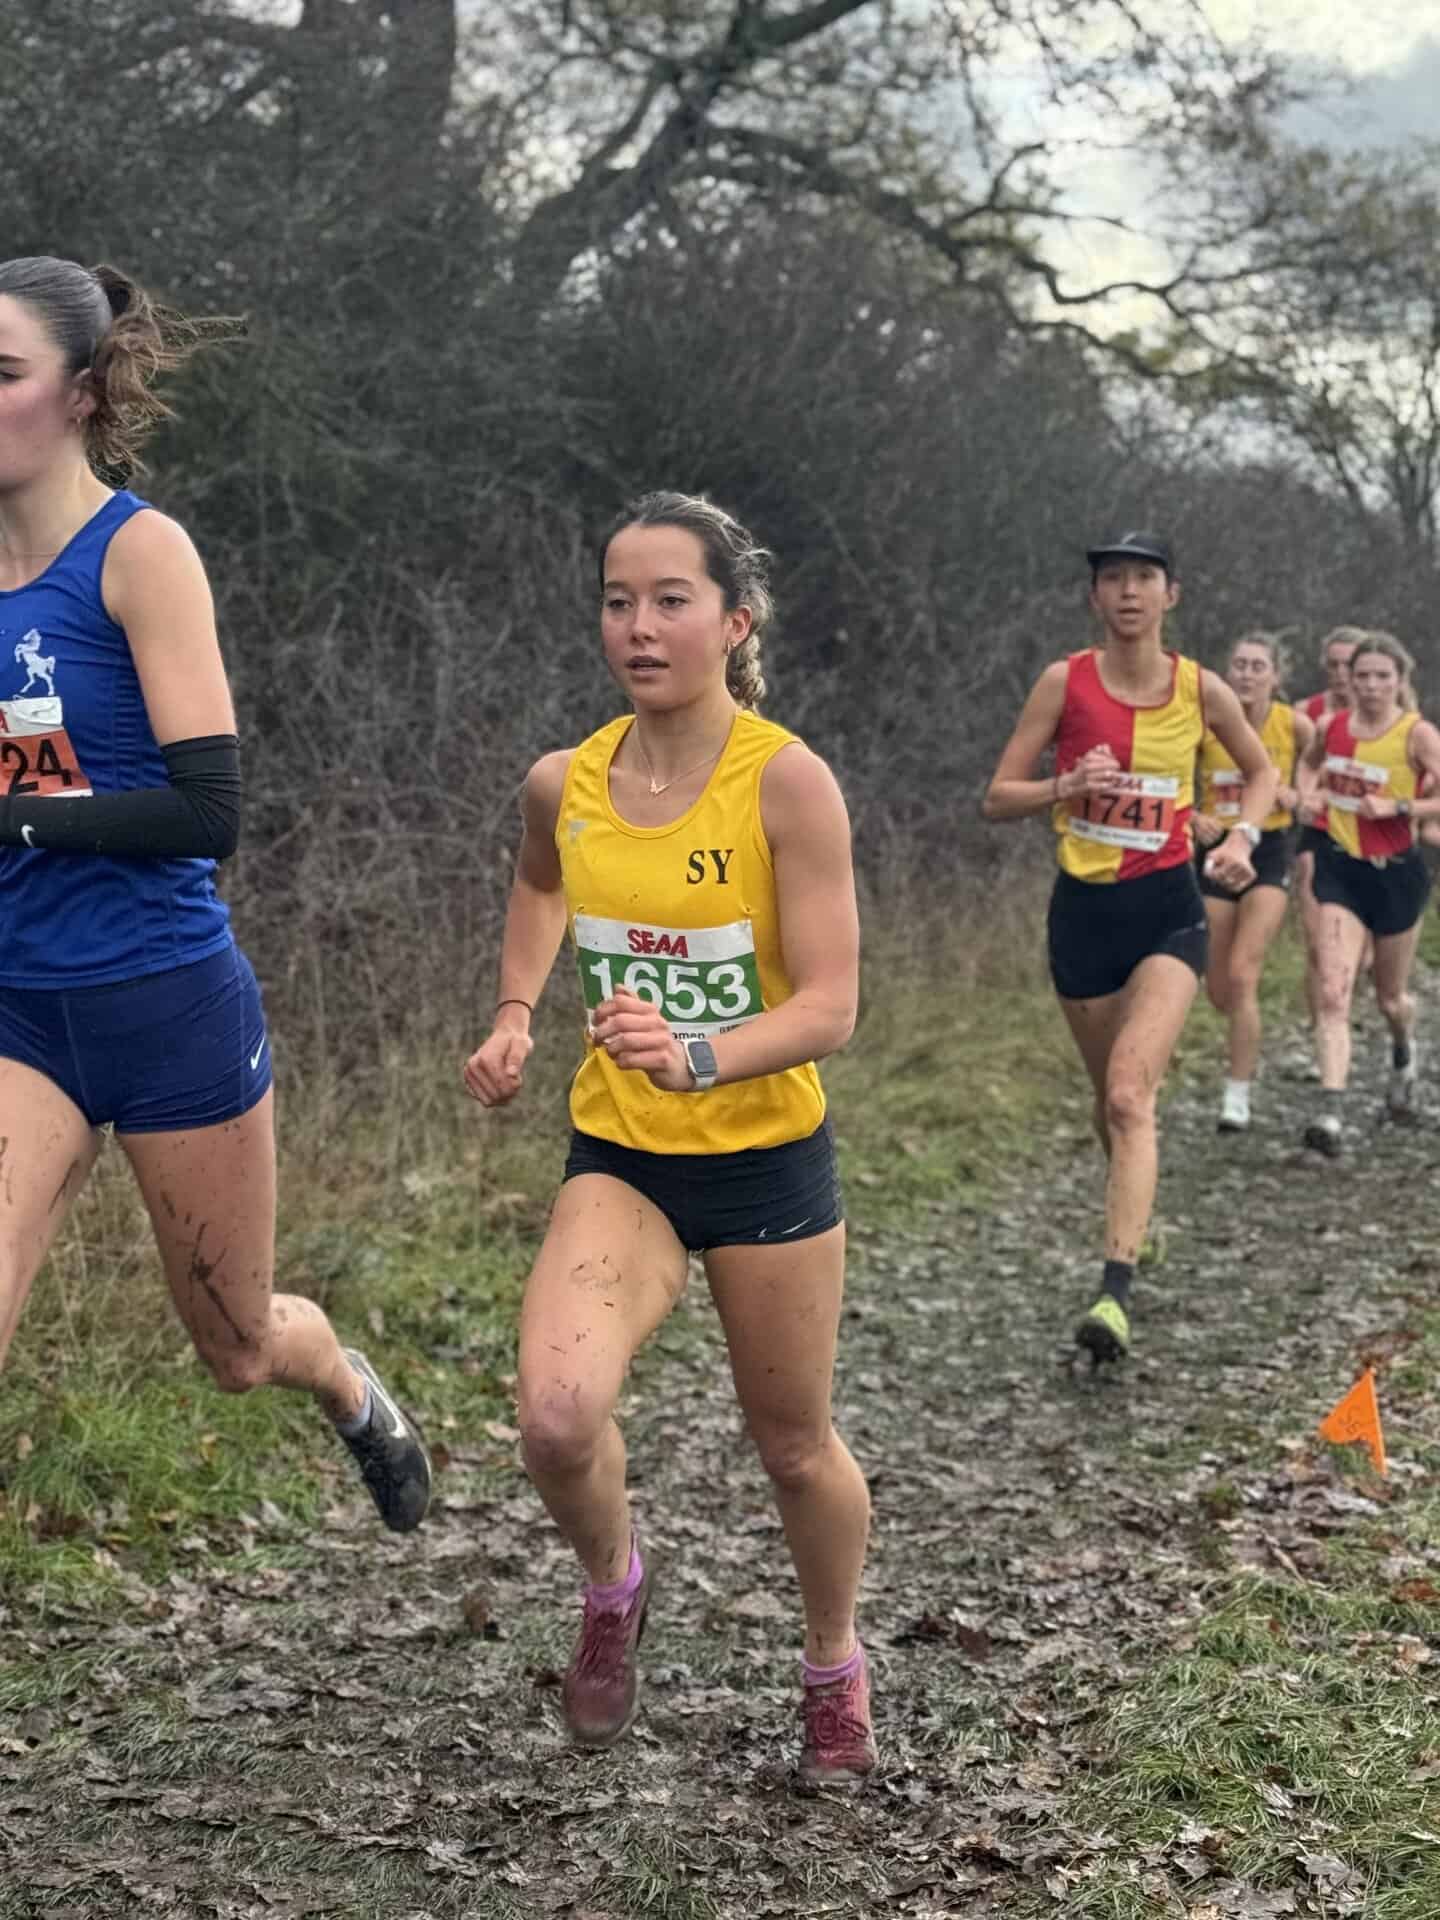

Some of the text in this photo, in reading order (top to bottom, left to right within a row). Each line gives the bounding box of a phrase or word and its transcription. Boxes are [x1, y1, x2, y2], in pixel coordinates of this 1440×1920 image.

[1079, 792, 1163, 833] 1741
[686, 849, 734, 884] SY
[627, 928, 688, 959] SEAA
[589, 958, 752, 1019] 1653
